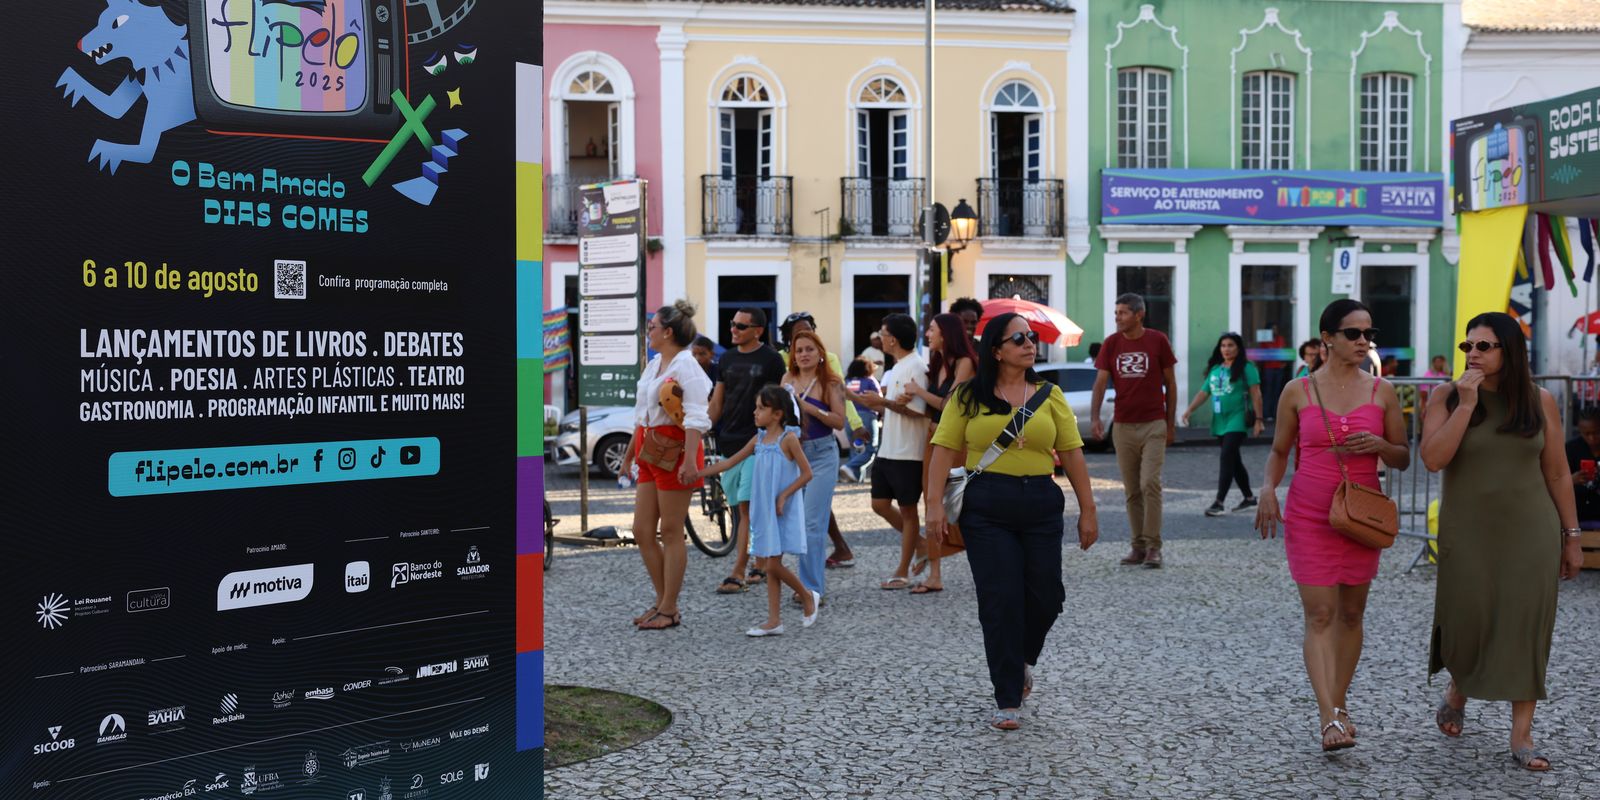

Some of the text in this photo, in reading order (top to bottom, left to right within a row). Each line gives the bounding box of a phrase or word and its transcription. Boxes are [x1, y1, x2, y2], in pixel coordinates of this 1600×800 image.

[295, 72, 344, 91] 2025
[1549, 101, 1592, 132] RODA
[171, 160, 346, 198] O Bem Amado
[1111, 186, 1263, 200] SERVIÇO DE ATENDIMENTO
[1154, 200, 1221, 211] AO TURISTA
[204, 199, 369, 233] DIAS GOMES
[83, 259, 259, 297] 6 a 10 de agosto
[319, 275, 448, 293] Confira programação completa
[80, 328, 255, 364] LANÇAMENTOS
[262, 331, 289, 357] DE
[296, 331, 367, 357] LIVROS
[384, 331, 464, 357] DEBATES
[81, 364, 152, 393] MÚSICA
[171, 368, 237, 391] POESIA
[253, 368, 306, 389] ARTES
[312, 362, 394, 388] PLÁSTICAS
[408, 365, 465, 387] TEATRO
[80, 400, 194, 421] GASTRONOMIA
[208, 393, 314, 419] PROGRAMAÇÃO
[317, 395, 377, 414] INFANTIL
[381, 395, 388, 411] E
[392, 394, 429, 411] MUITO
[433, 394, 464, 410] MAIS!
[135, 453, 299, 486] flipelo.com.br
[410, 560, 442, 571] Banco do
[457, 565, 490, 576] SALVADOR
[347, 574, 368, 586] itaú
[410, 570, 442, 581] Nordeste
[253, 576, 302, 594] motiva
[74, 596, 112, 606] Lei Rouanet
[129, 594, 167, 609] cultura
[272, 637, 286, 645] Apoio:
[212, 645, 226, 654] Apoio
[80, 658, 146, 673] Patrocínio SARAMANDAIA:
[305, 687, 334, 697] embasa
[343, 680, 371, 691] CONDER
[212, 713, 245, 725] Rede Bahia
[450, 729, 463, 739] VALE
[472, 724, 489, 735] DENDÊ
[33, 738, 75, 755] SICOOB
[258, 772, 279, 782] UFBA
